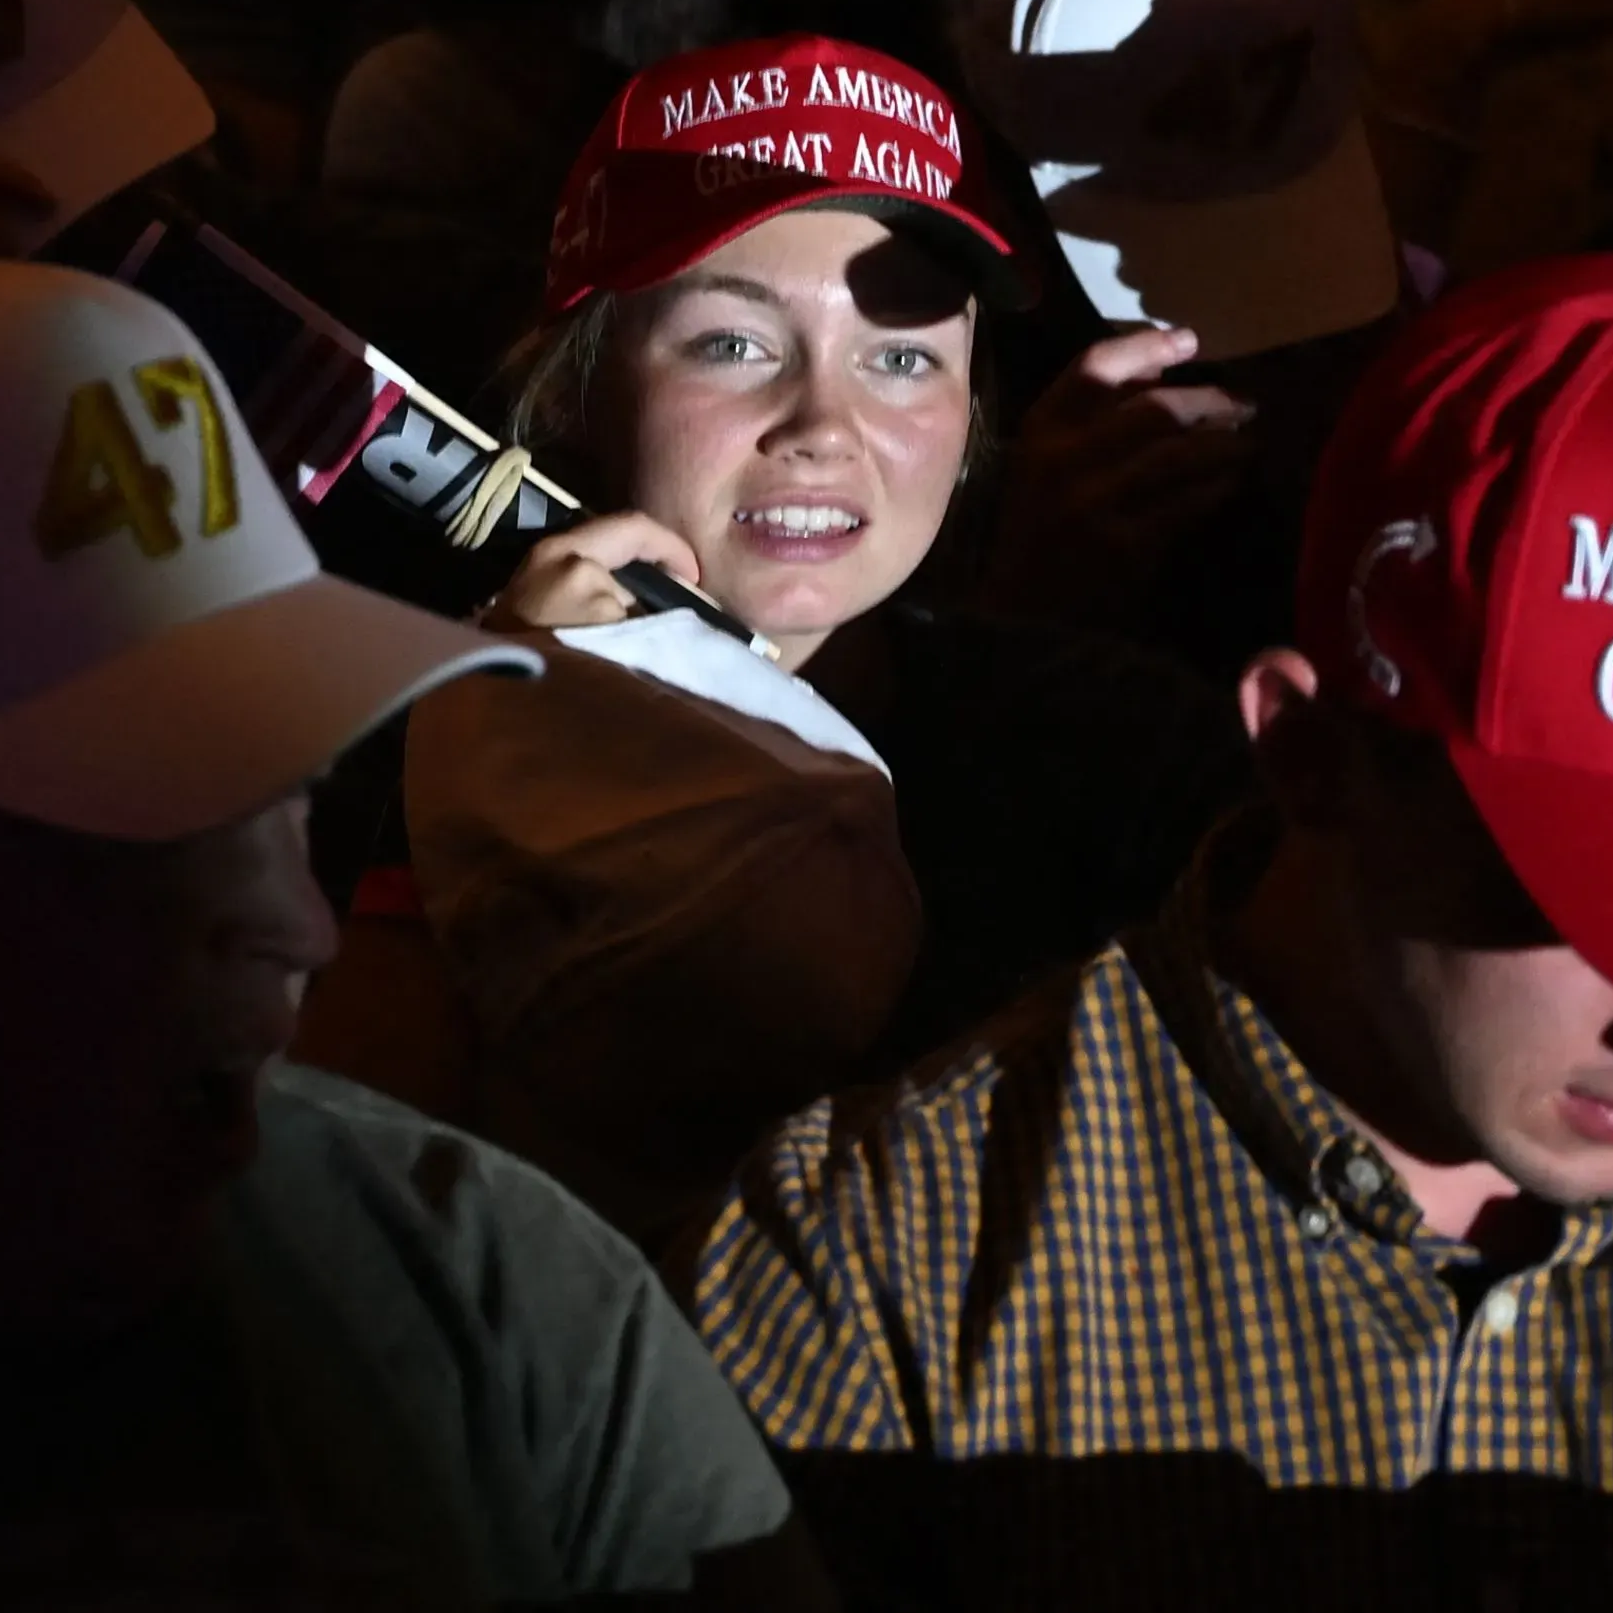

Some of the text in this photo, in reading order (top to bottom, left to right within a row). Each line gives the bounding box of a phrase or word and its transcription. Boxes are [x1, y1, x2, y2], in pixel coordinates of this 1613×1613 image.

[659, 62, 963, 166] MAKE AMERICA
[693, 129, 955, 201] GREAT AGAIN
[31, 355, 239, 562] 47
